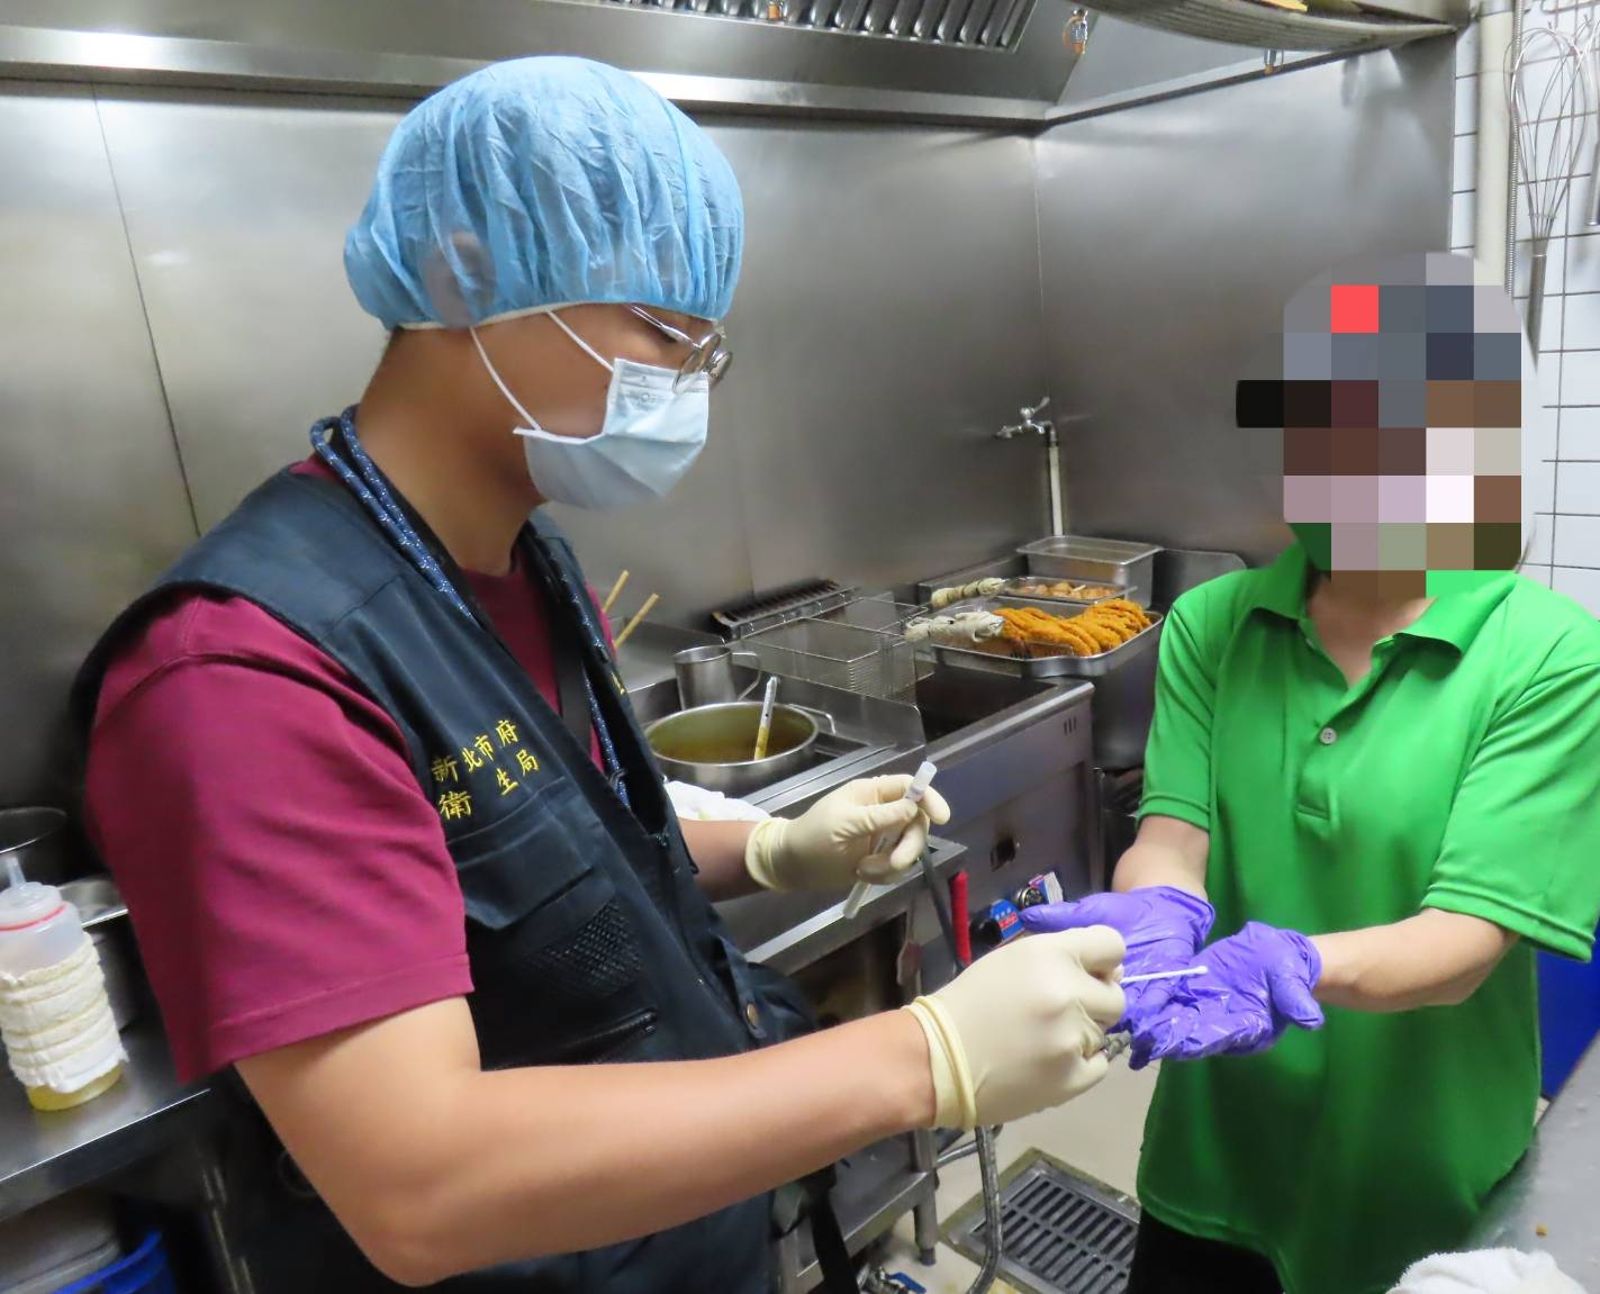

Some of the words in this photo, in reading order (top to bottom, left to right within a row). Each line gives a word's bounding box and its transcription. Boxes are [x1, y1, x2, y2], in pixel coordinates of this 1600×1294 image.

[432, 719, 518, 783] 新北市府
[439, 749, 540, 819] 衛生局
